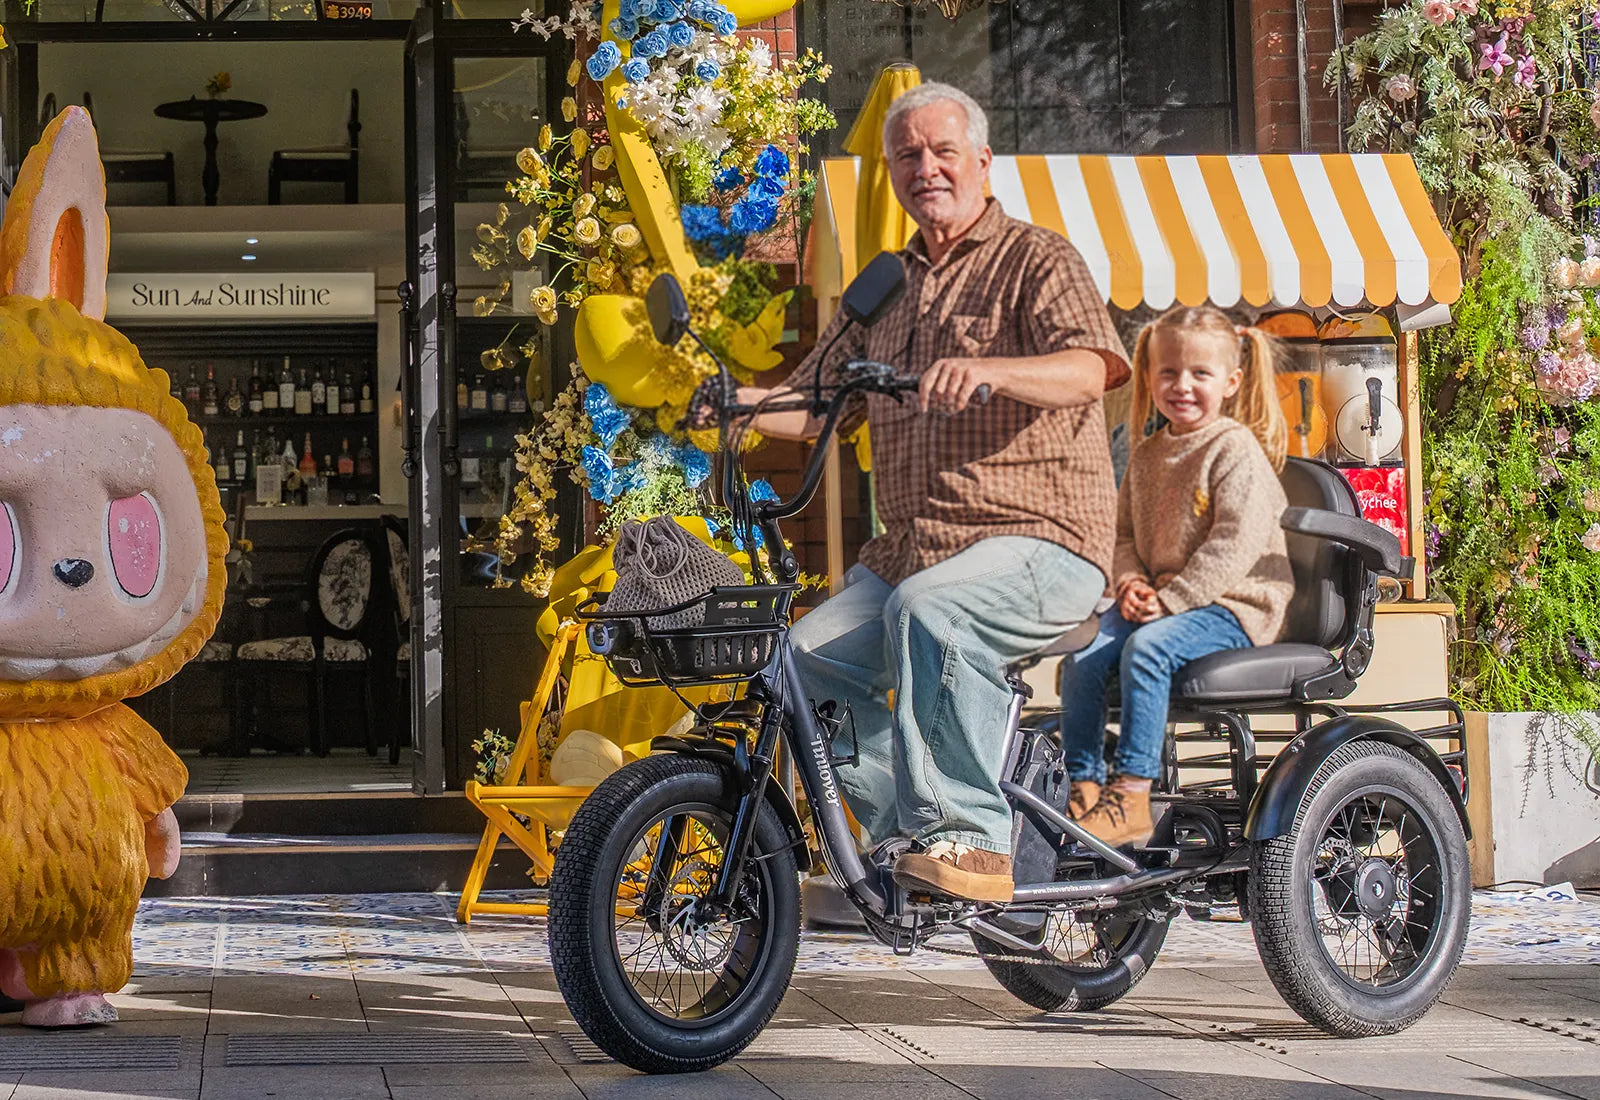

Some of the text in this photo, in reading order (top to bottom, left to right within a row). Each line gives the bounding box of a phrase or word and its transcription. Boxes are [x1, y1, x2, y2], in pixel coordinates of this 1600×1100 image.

[339, 6, 371, 20] 3949
[132, 282, 331, 307] Sun And Sunshine
[1361, 496, 1397, 511] ychee
